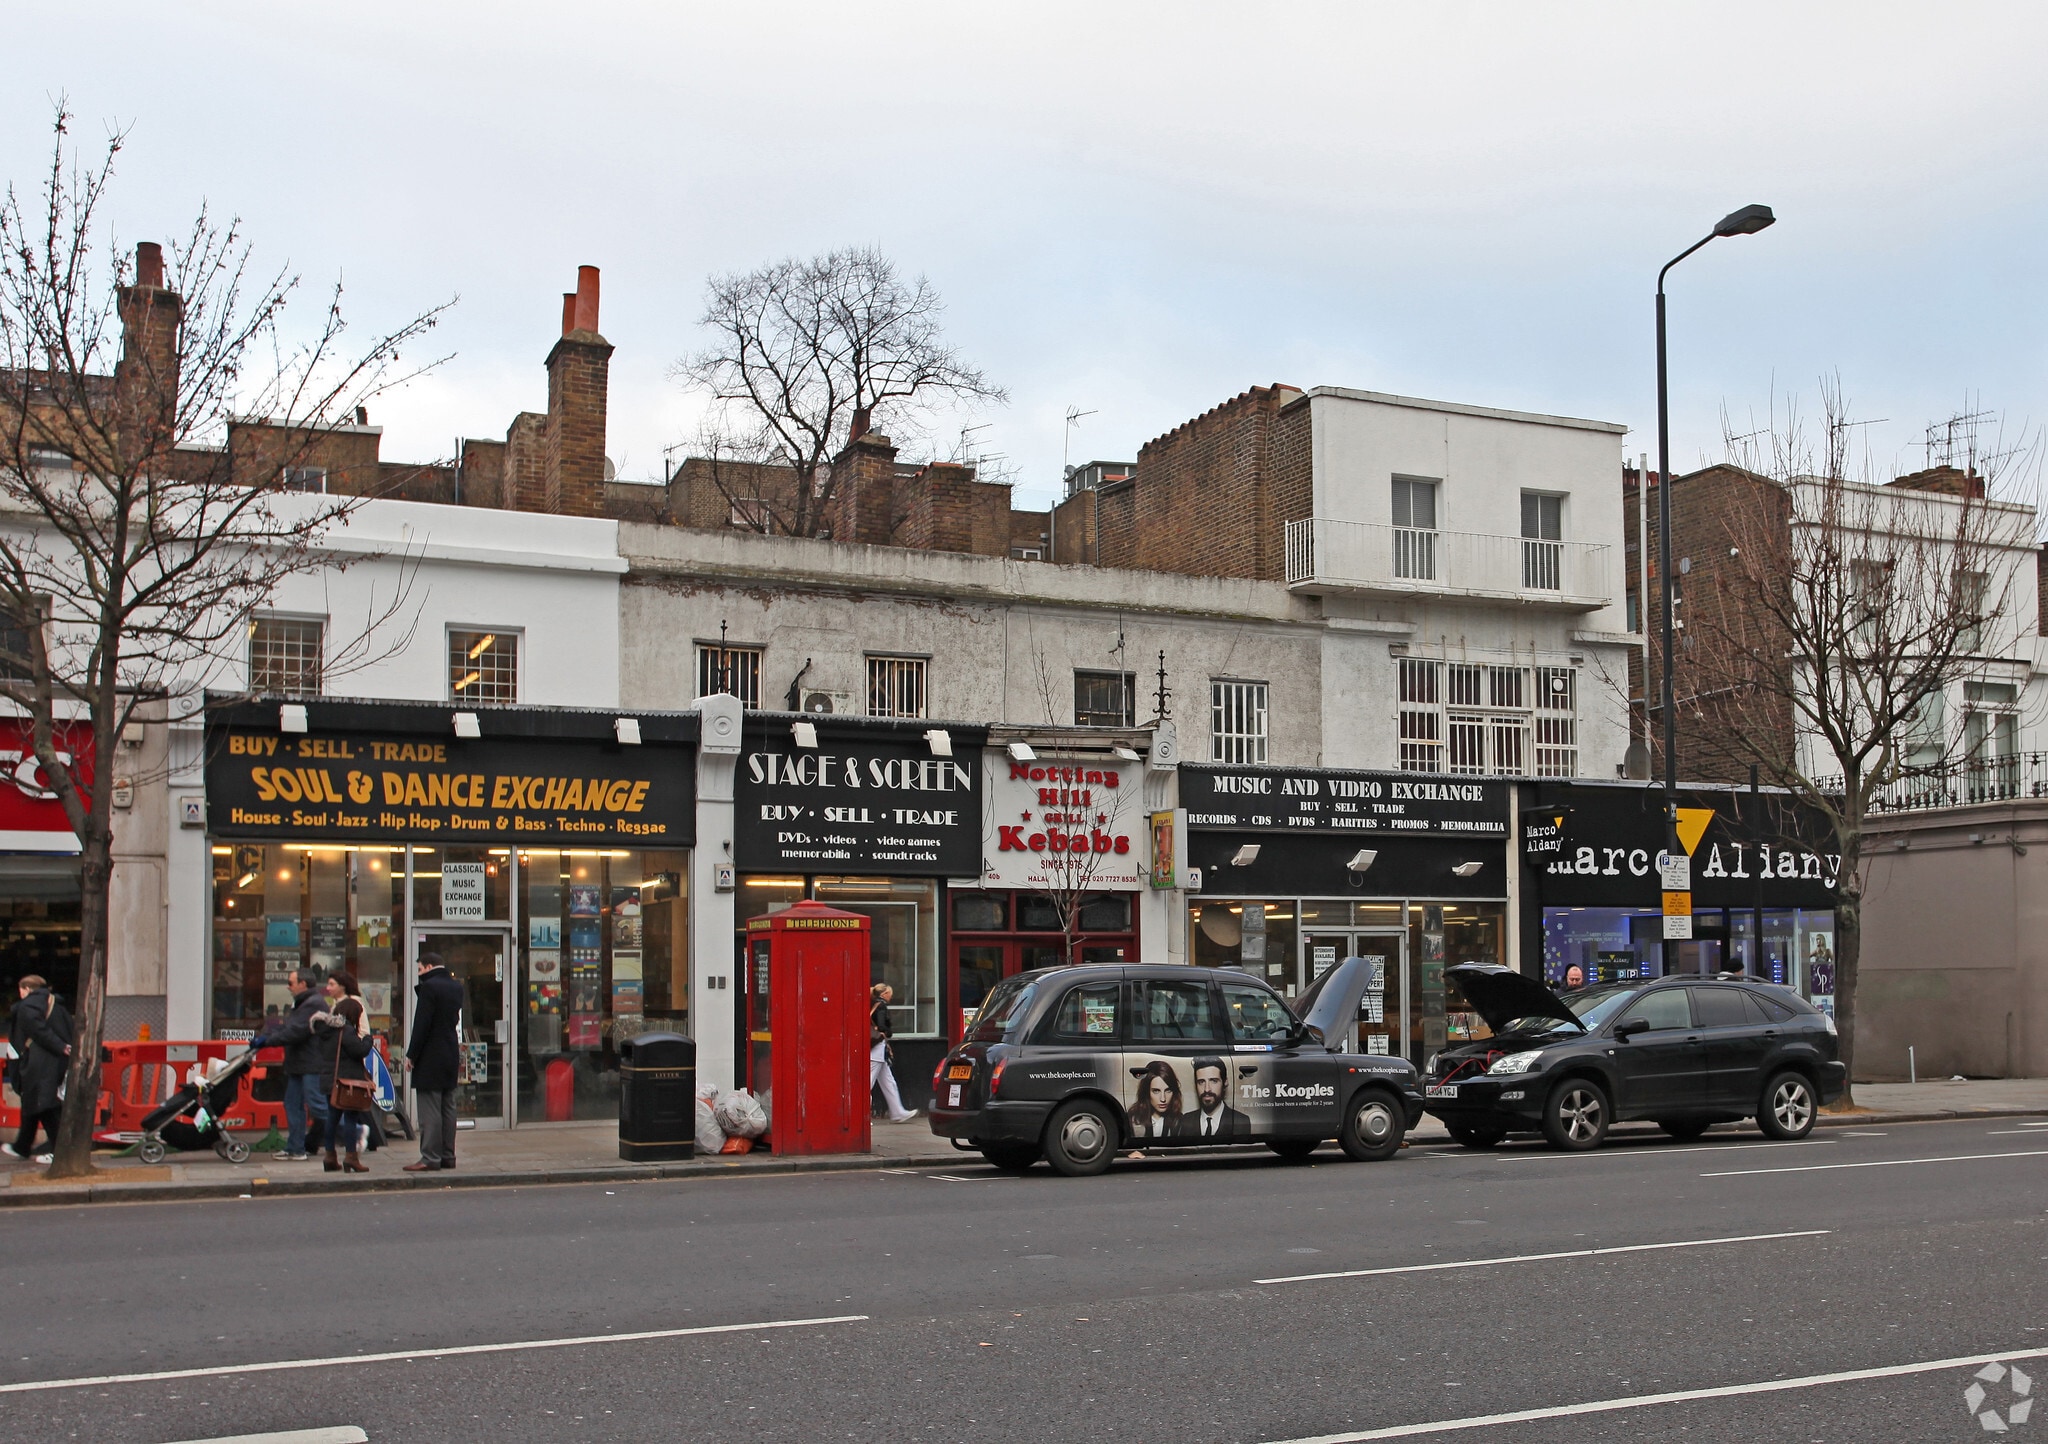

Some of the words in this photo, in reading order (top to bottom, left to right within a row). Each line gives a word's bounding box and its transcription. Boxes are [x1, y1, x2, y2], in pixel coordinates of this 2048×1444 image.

[229, 735, 279, 756] BUY
[298, 739, 355, 759] SELL
[370, 741, 447, 763] TRADE
[748, 752, 837, 787] STAGE
[844, 757, 862, 788] &
[868, 757, 971, 792] SCREEN
[1009, 762, 1119, 788] Notting
[251, 766, 343, 803] SOUL
[347, 770, 374, 804] &
[382, 771, 485, 808] DANCE
[491, 775, 650, 813] EXCHANGE
[1213, 775, 1272, 794] MUSIC
[1280, 778, 1320, 796] AND
[1328, 780, 1382, 798] VIDEO
[1391, 782, 1483, 802] EXCHANGE
[1038, 788, 1092, 807] Hill
[1300, 801, 1321, 811] BUY
[1335, 803, 1358, 813] SELL
[1372, 804, 1405, 814] TRADE
[231, 808, 281, 825] House
[292, 810, 327, 827] Soul
[336, 811, 368, 827] Jazz
[380, 812, 406, 831] Hip
[409, 813, 440, 831] Hop
[451, 814, 490, 830] Drum
[496, 815, 509, 831] &
[515, 816, 546, 831] Bass
[556, 817, 605, 833] Techno
[616, 818, 666, 835] Reggae
[761, 804, 805, 821] BUY
[823, 806, 874, 823] SELL
[892, 808, 958, 826] TRADE
[1044, 813, 1085, 825] GRILL
[1188, 814, 1237, 824] RECORDS
[1252, 815, 1272, 825] CDS
[1288, 816, 1315, 826] DVDS
[1331, 817, 1377, 829] RARITIES
[1391, 819, 1429, 830] PROMOS
[1441, 820, 1505, 832] MEMORABILIA
[1526, 826, 1556, 838] Marco
[778, 831, 811, 844] DVDs
[823, 834, 857, 846] videos
[877, 836, 905, 847] video
[907, 837, 941, 848] games
[998, 825, 1130, 854] Kebabs
[781, 849, 850, 860] memorabilia
[872, 850, 937, 861] soundtracks
[1663, 857, 1669, 865] P
[444, 865, 484, 874] CLASSICAL
[1041, 860, 1064, 870] SINCE
[1068, 860, 1083, 870] 975
[452, 880, 476, 888] MUSIC
[1092, 875, 1104, 883] 020
[1105, 875, 1120, 883] 7727
[445, 893, 482, 901] EXCHANGE
[445, 907, 458, 915] 1ST
[459, 907, 482, 915] FLOOR
[791, 919, 855, 928] TELEPHONE
[1029, 1071, 1096, 1079] www.thekooples.com
[1240, 1084, 1270, 1098] The
[1275, 1083, 1335, 1099] Kooples
